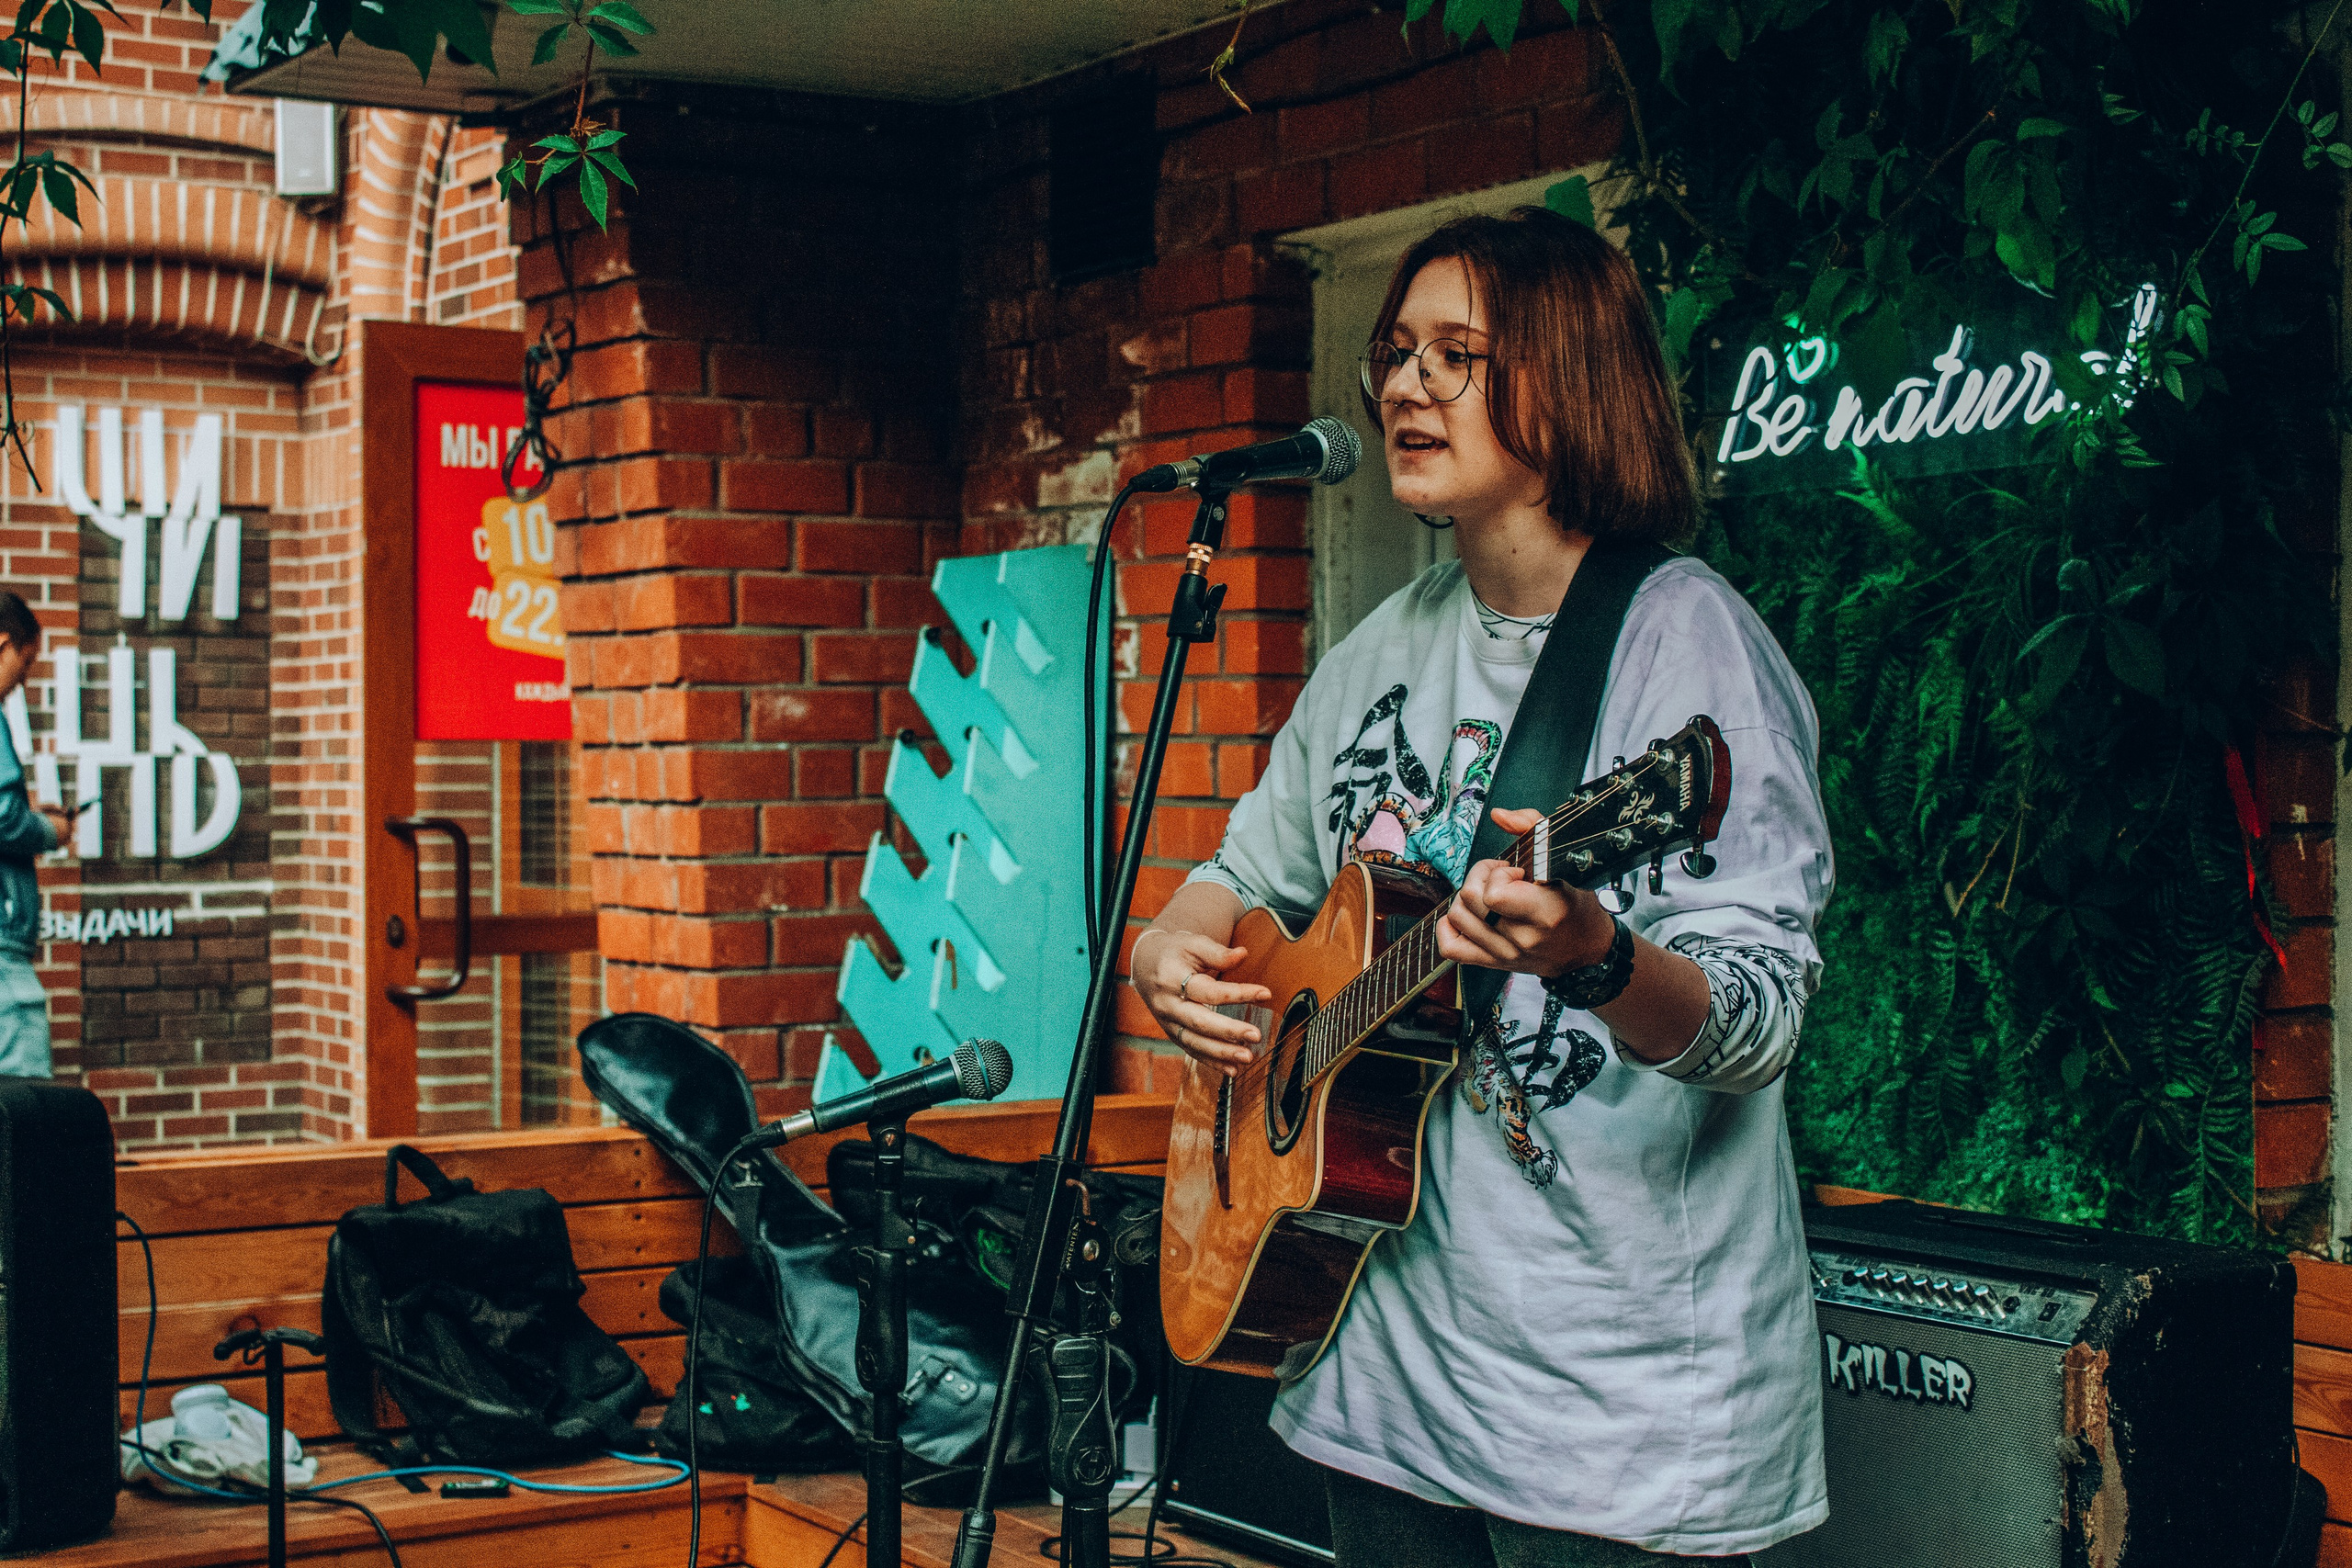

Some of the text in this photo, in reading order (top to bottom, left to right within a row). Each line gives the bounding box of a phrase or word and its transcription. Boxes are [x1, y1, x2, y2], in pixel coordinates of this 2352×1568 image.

[1716, 283, 2158, 462] Be naturl
[441, 423, 499, 469] МЫ
[503, 502, 555, 566] 10
[1679, 753, 1691, 812] YAMAHA
[1825, 1333, 1973, 1409] KILLER
